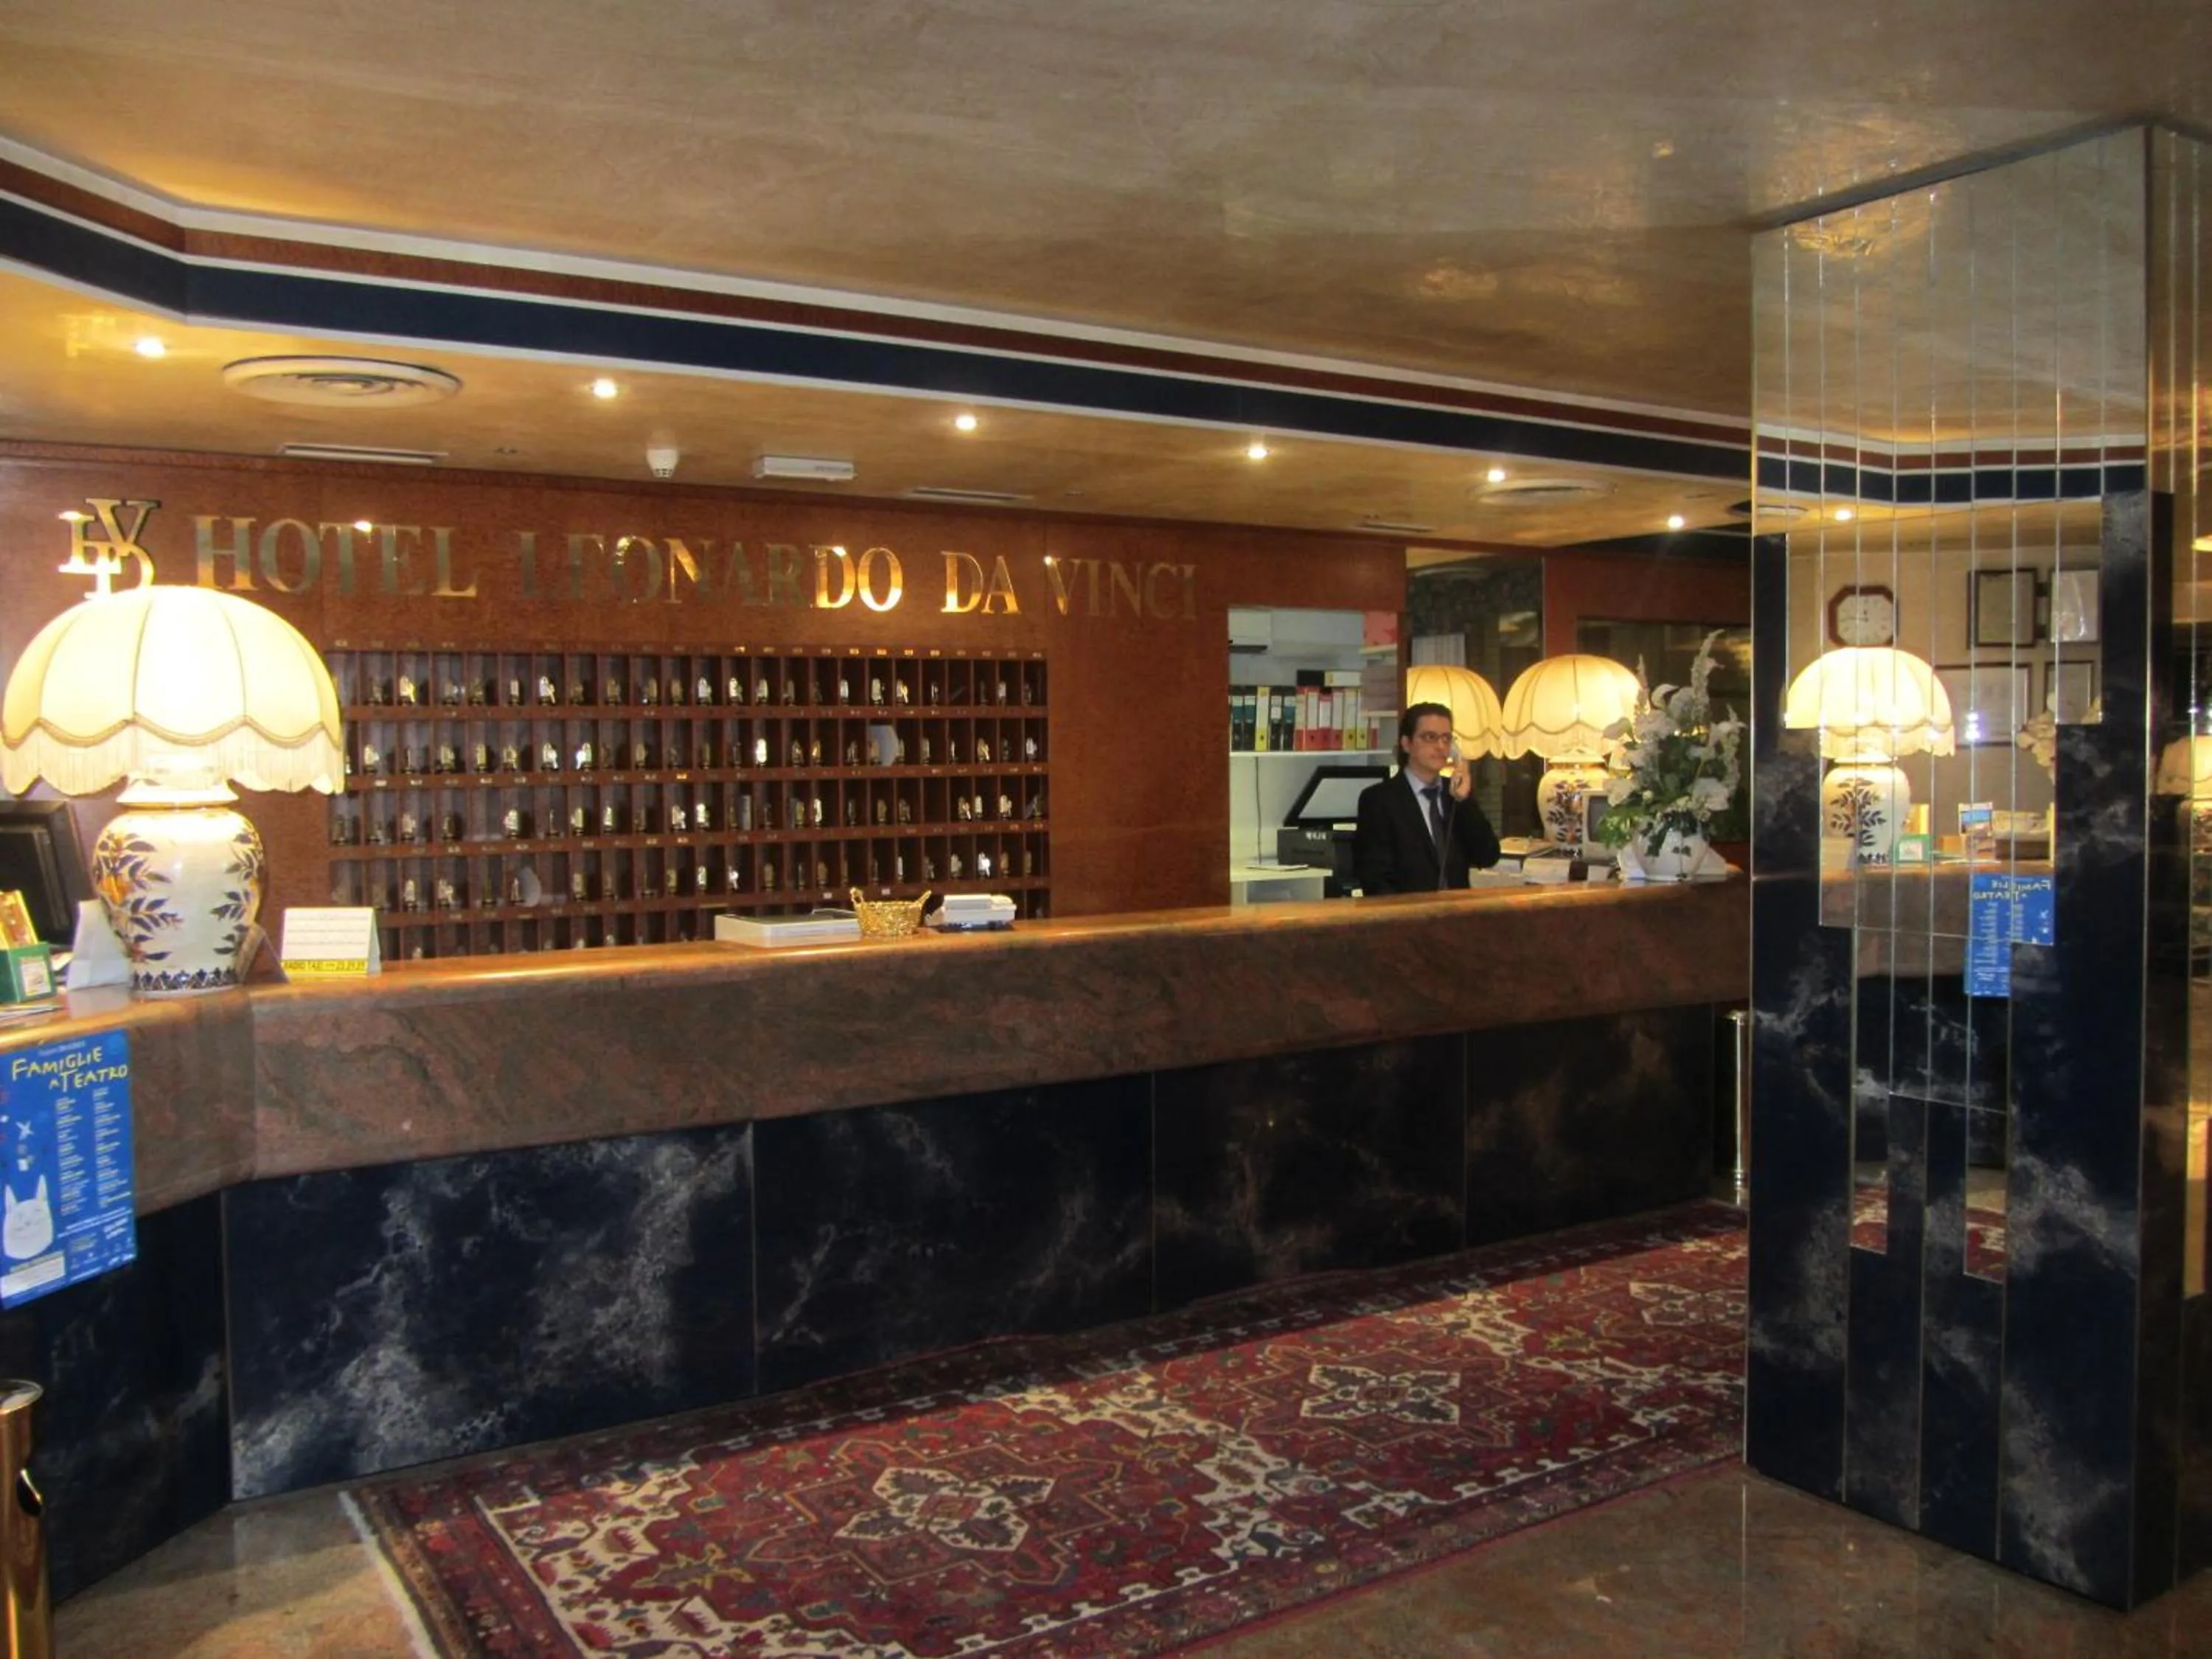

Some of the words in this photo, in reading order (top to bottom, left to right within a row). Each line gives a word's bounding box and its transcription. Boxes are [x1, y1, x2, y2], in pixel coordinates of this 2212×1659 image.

[194, 515, 477, 597] HOTEL
[516, 529, 903, 612] LEONARDO
[939, 550, 1021, 615] DA
[1043, 555, 1197, 621] VINCI
[12, 1046, 102, 1082] FAMIGLIE
[60, 1064, 128, 1093] TEATRO
